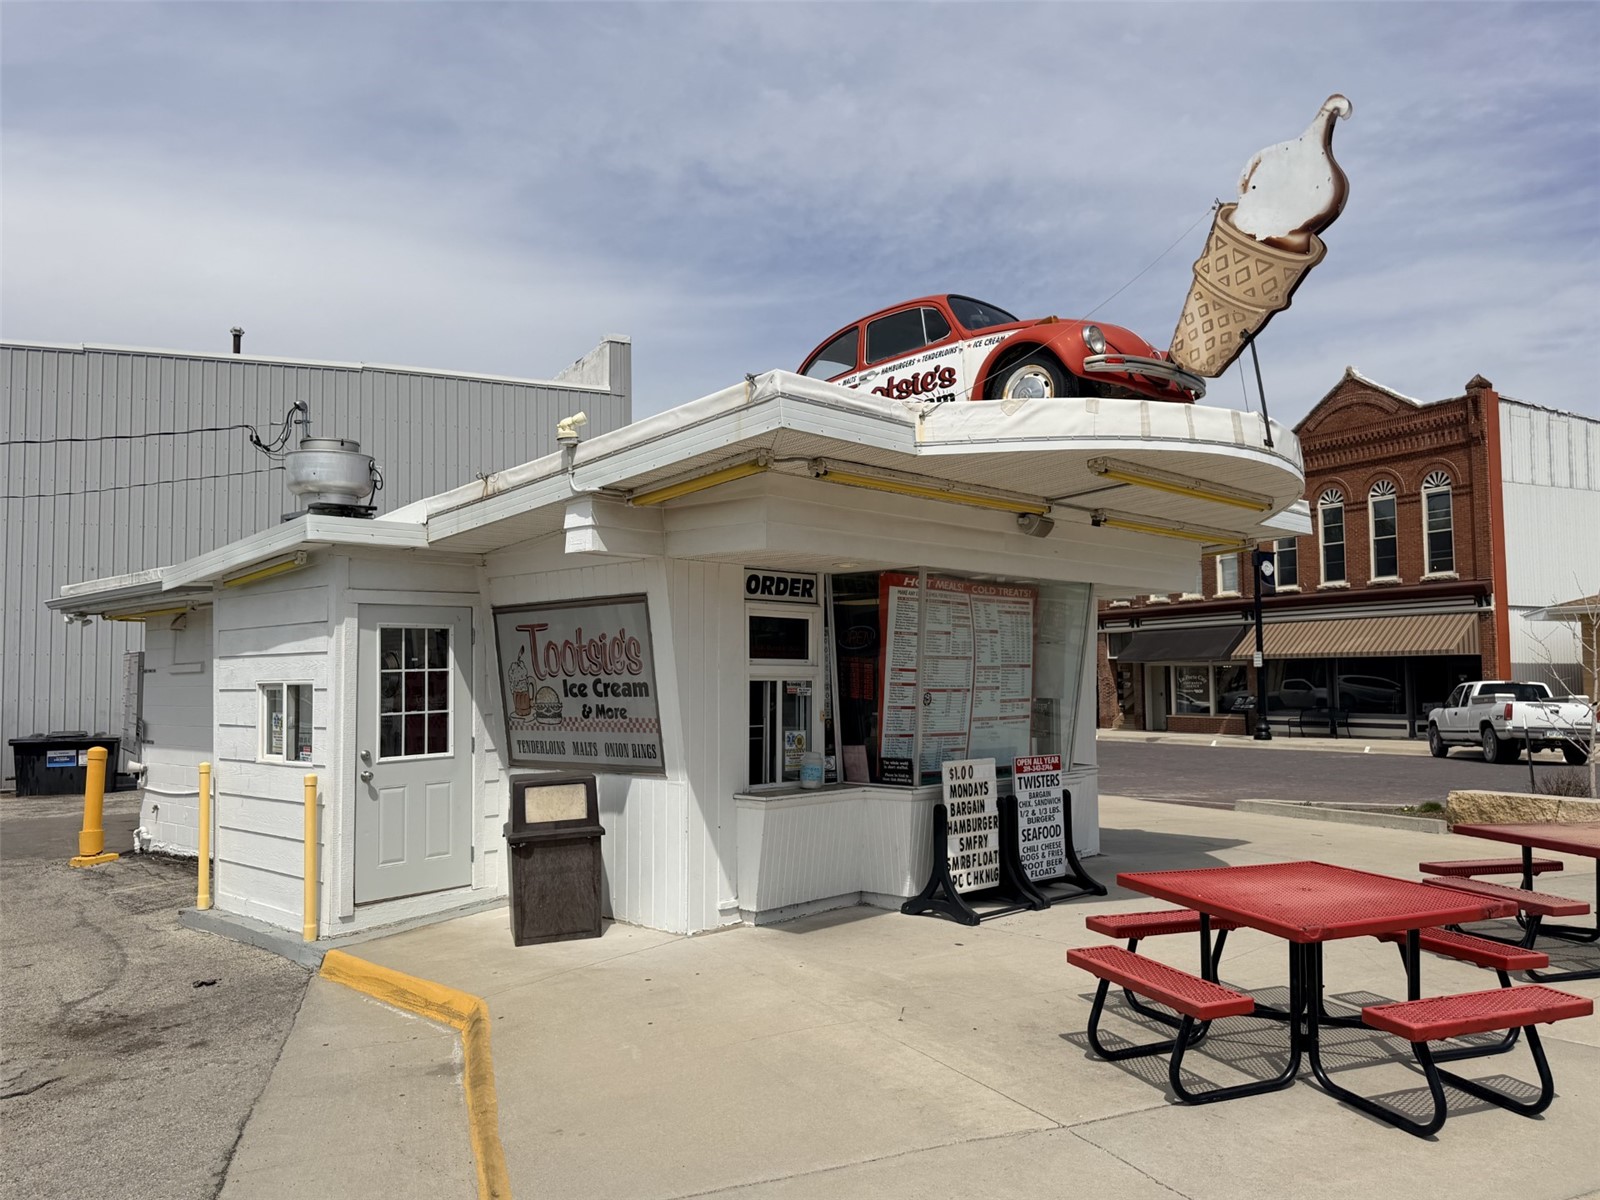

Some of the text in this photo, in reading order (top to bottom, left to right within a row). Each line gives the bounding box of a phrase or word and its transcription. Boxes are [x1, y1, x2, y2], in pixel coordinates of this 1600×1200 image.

[842, 336, 1006, 386] MALTS HAMBURGERS TENDERLOINS ICE CREAM
[870, 364, 957, 400] otsie's
[746, 574, 816, 598] ORDER
[936, 580, 964, 592] MEALS!
[971, 585, 996, 595] COLD
[998, 588, 1032, 598] TREATS!
[516, 623, 643, 680] Tootsie's
[562, 678, 650, 698] Ice Cream
[582, 704, 628, 719] & More
[516, 740, 657, 759] TENDERLOINS MALTS ONION RINGS
[1017, 758, 1032, 766] OPEN
[949, 764, 974, 781] $1.00
[950, 781, 989, 798] MONDAYS
[1018, 774, 1060, 790] TWISTERS
[1028, 791, 1051, 799] BARGAIN
[1034, 797, 1061, 806] SANDWICH
[950, 799, 985, 817] BARGAIN
[1049, 806, 1061, 814] LBS.
[947, 815, 998, 836] HAMBURGER
[1027, 814, 1056, 824] BURGERS
[1022, 824, 1062, 842] SEAFOOD
[1021, 852, 1039, 862] DOGS
[1048, 848, 1063, 857] FRIES
[1022, 841, 1062, 854] CHILI CHEESE
[1023, 858, 1063, 870] ROOT BEER
[1031, 867, 1056, 878] FLOATS
